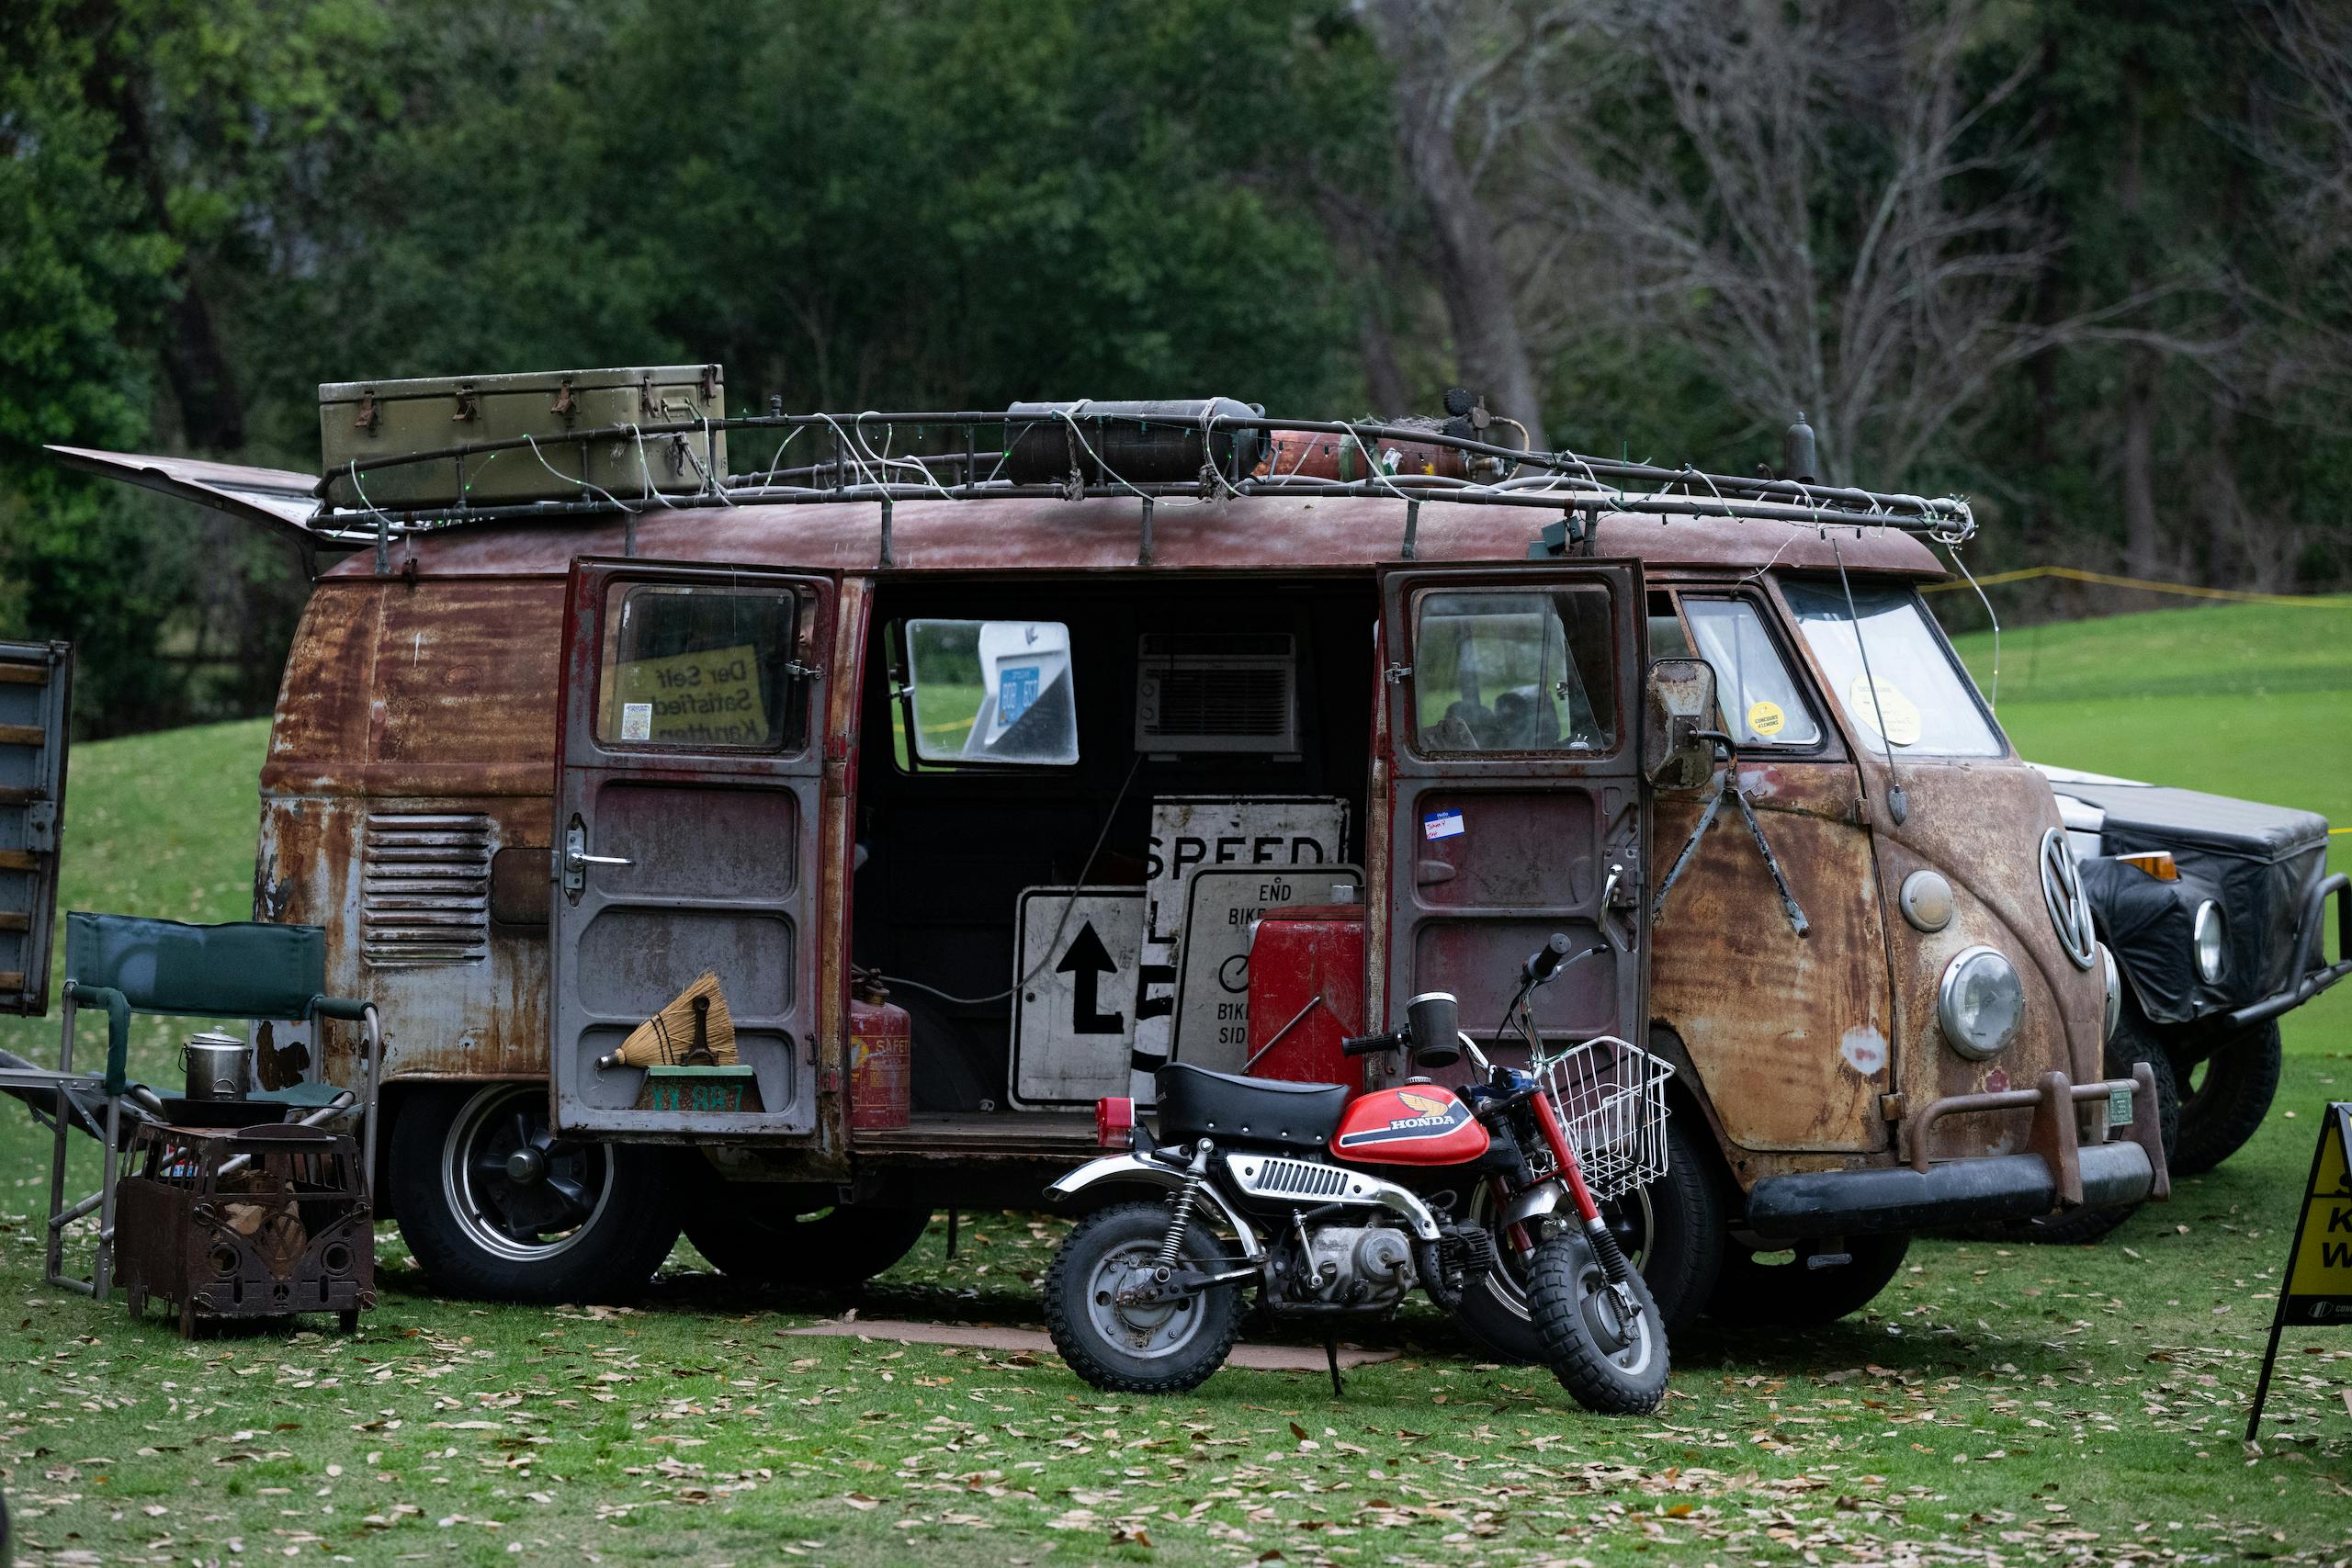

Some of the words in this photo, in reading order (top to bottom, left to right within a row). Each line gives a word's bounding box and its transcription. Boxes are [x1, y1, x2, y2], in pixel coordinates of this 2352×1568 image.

[1147, 837, 1324, 880] SPEED
[1260, 885, 1292, 901] END
[1148, 900, 1178, 943] L
[1219, 1027, 1250, 1043] SID
[876, 1038, 909, 1054] SAFET
[1390, 1115, 1455, 1131] HONDA
[2328, 1206, 2352, 1232] K
[2335, 1304, 2352, 1313] CON
